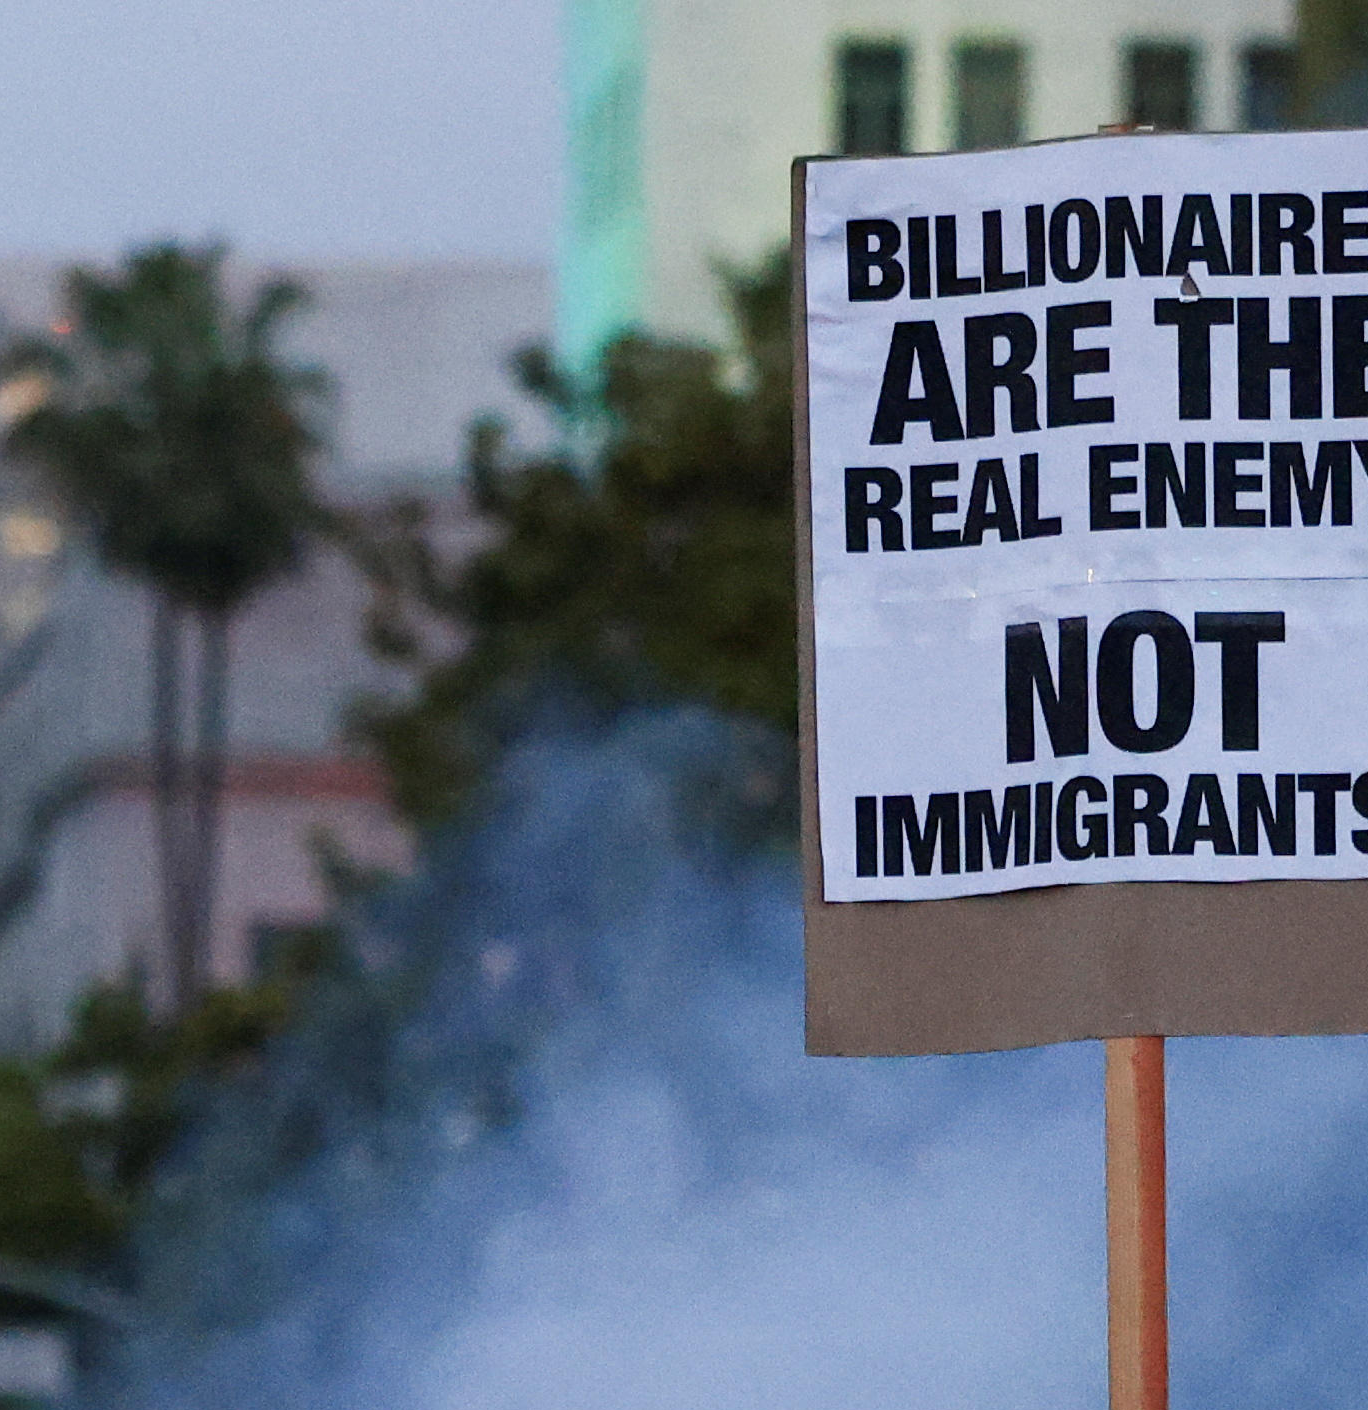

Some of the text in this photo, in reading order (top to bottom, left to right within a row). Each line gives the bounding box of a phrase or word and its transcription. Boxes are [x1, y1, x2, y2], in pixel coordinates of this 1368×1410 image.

[869, 300, 1116, 446] ARE
[844, 452, 1063, 554] REAL
[1004, 609, 1286, 765] NOT
